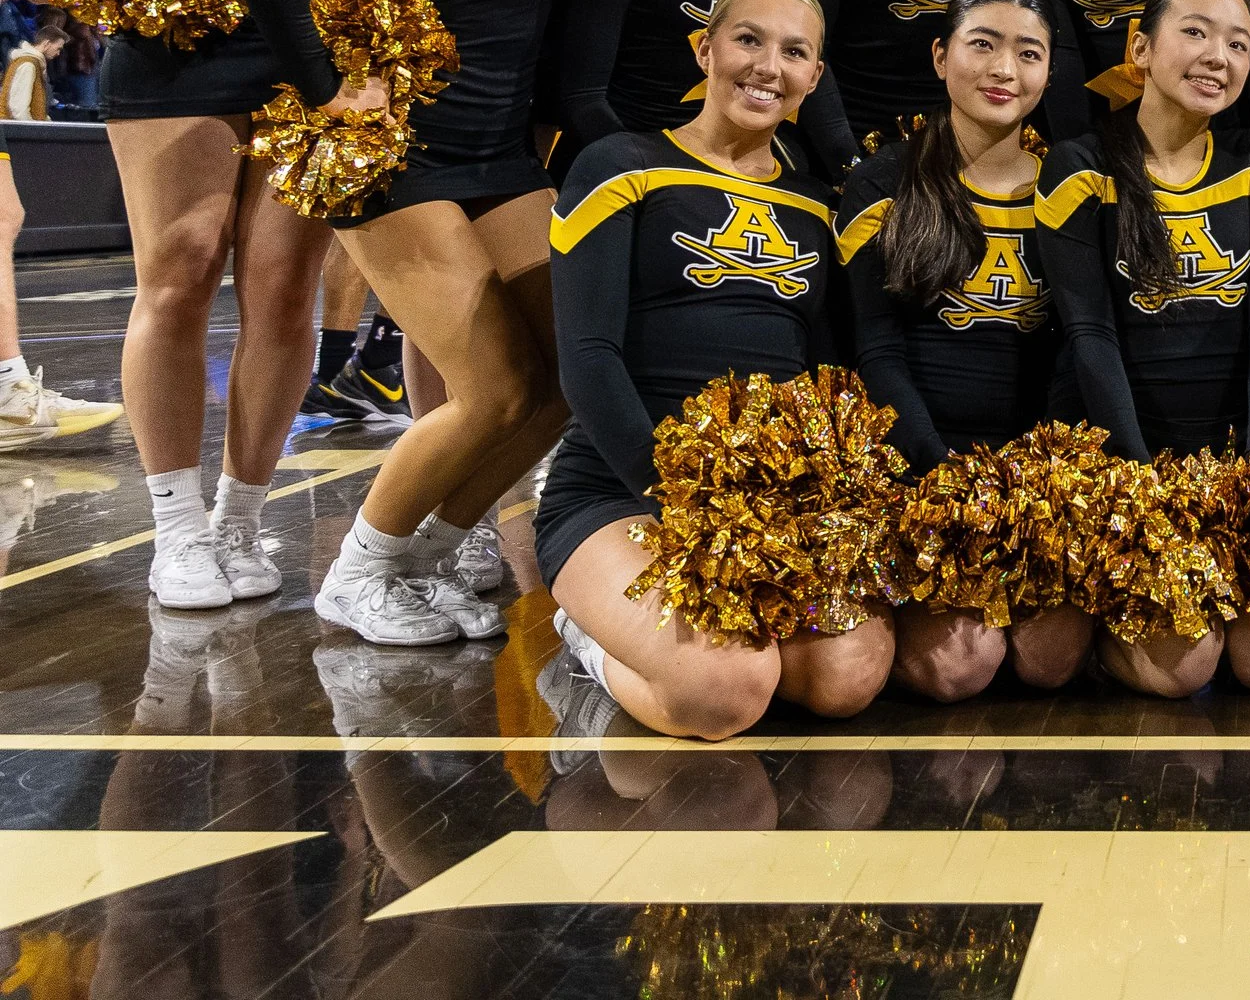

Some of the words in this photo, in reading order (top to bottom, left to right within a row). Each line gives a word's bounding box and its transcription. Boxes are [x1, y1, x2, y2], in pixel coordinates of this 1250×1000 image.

[707, 193, 798, 261] A
[1160, 212, 1236, 277] A
[963, 233, 1042, 299] A
